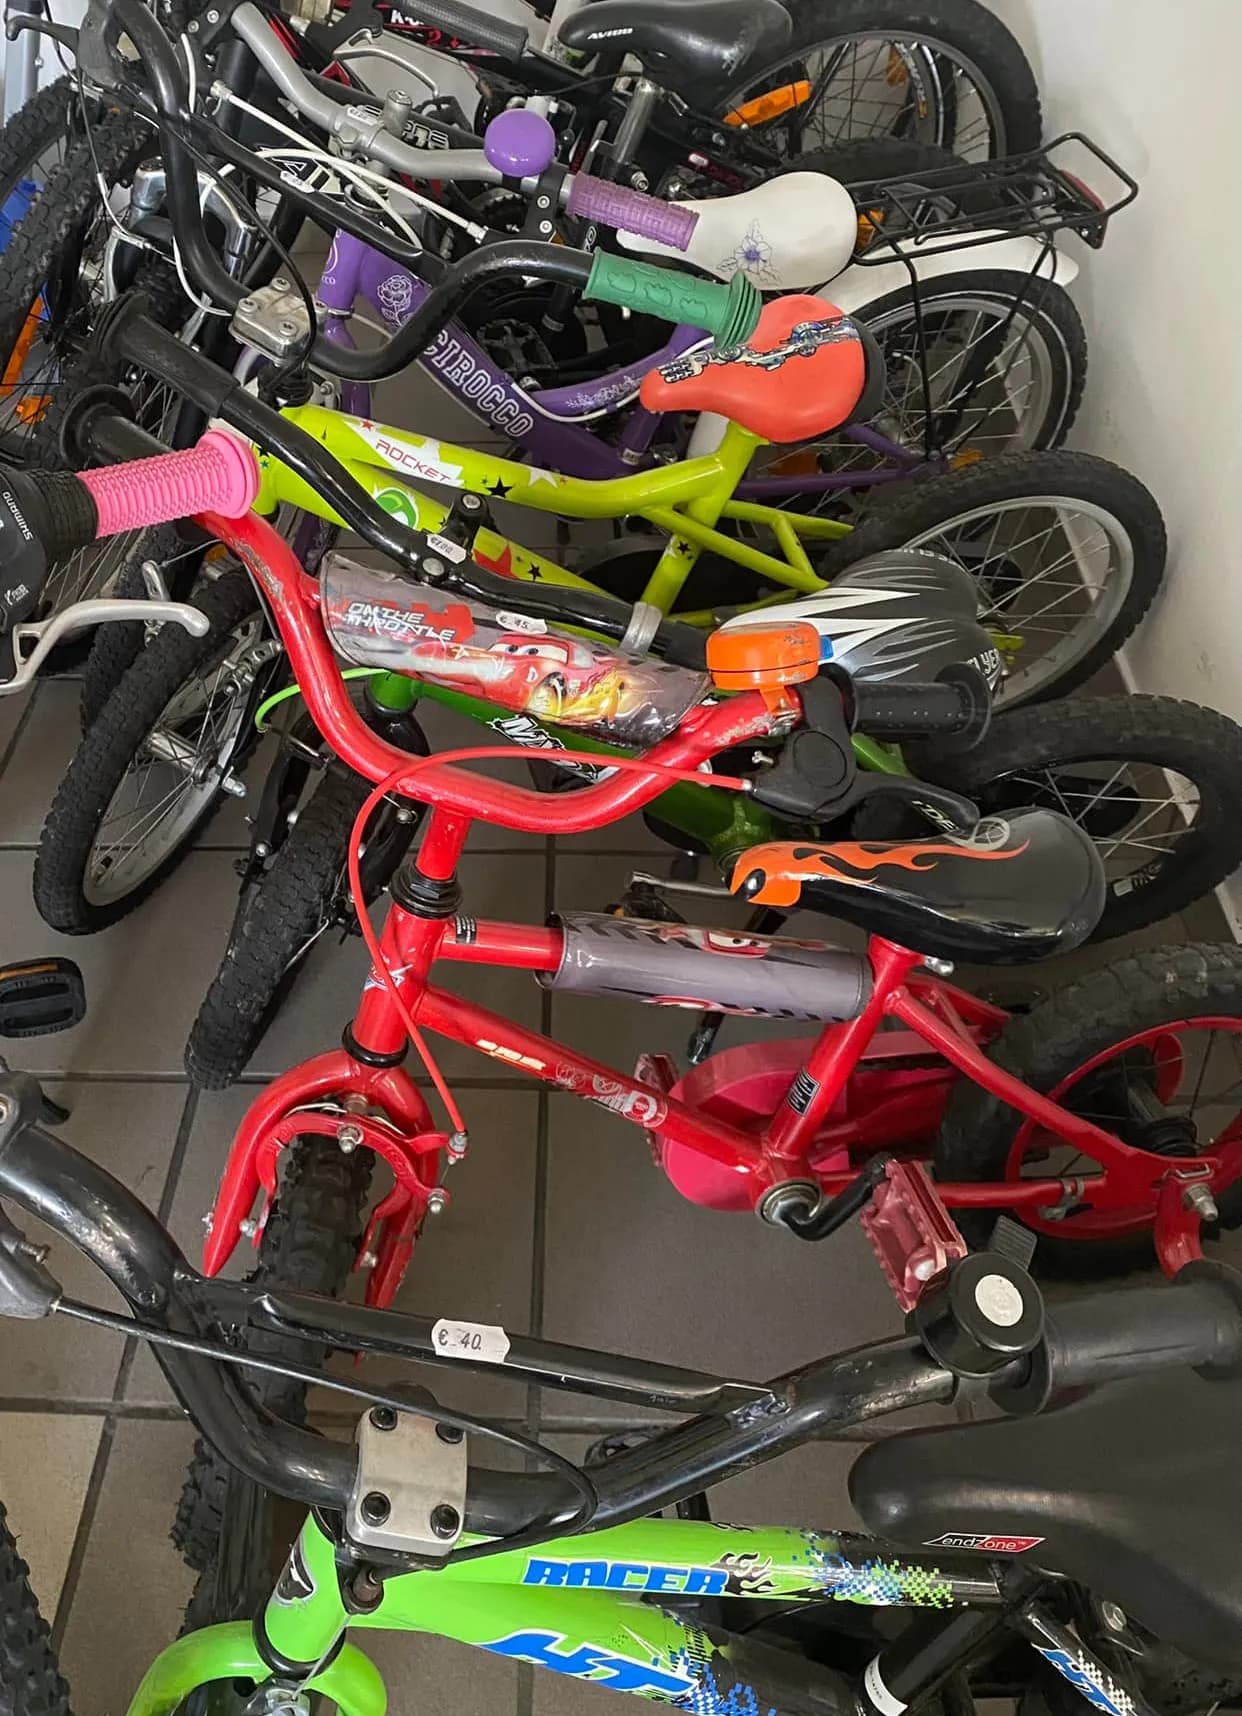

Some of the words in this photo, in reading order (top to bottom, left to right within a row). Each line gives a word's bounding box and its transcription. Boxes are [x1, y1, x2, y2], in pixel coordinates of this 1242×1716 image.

[375, 439, 452, 482] ROCKET
[381, 607, 425, 625] THE
[521, 1557, 730, 1596] RACER
